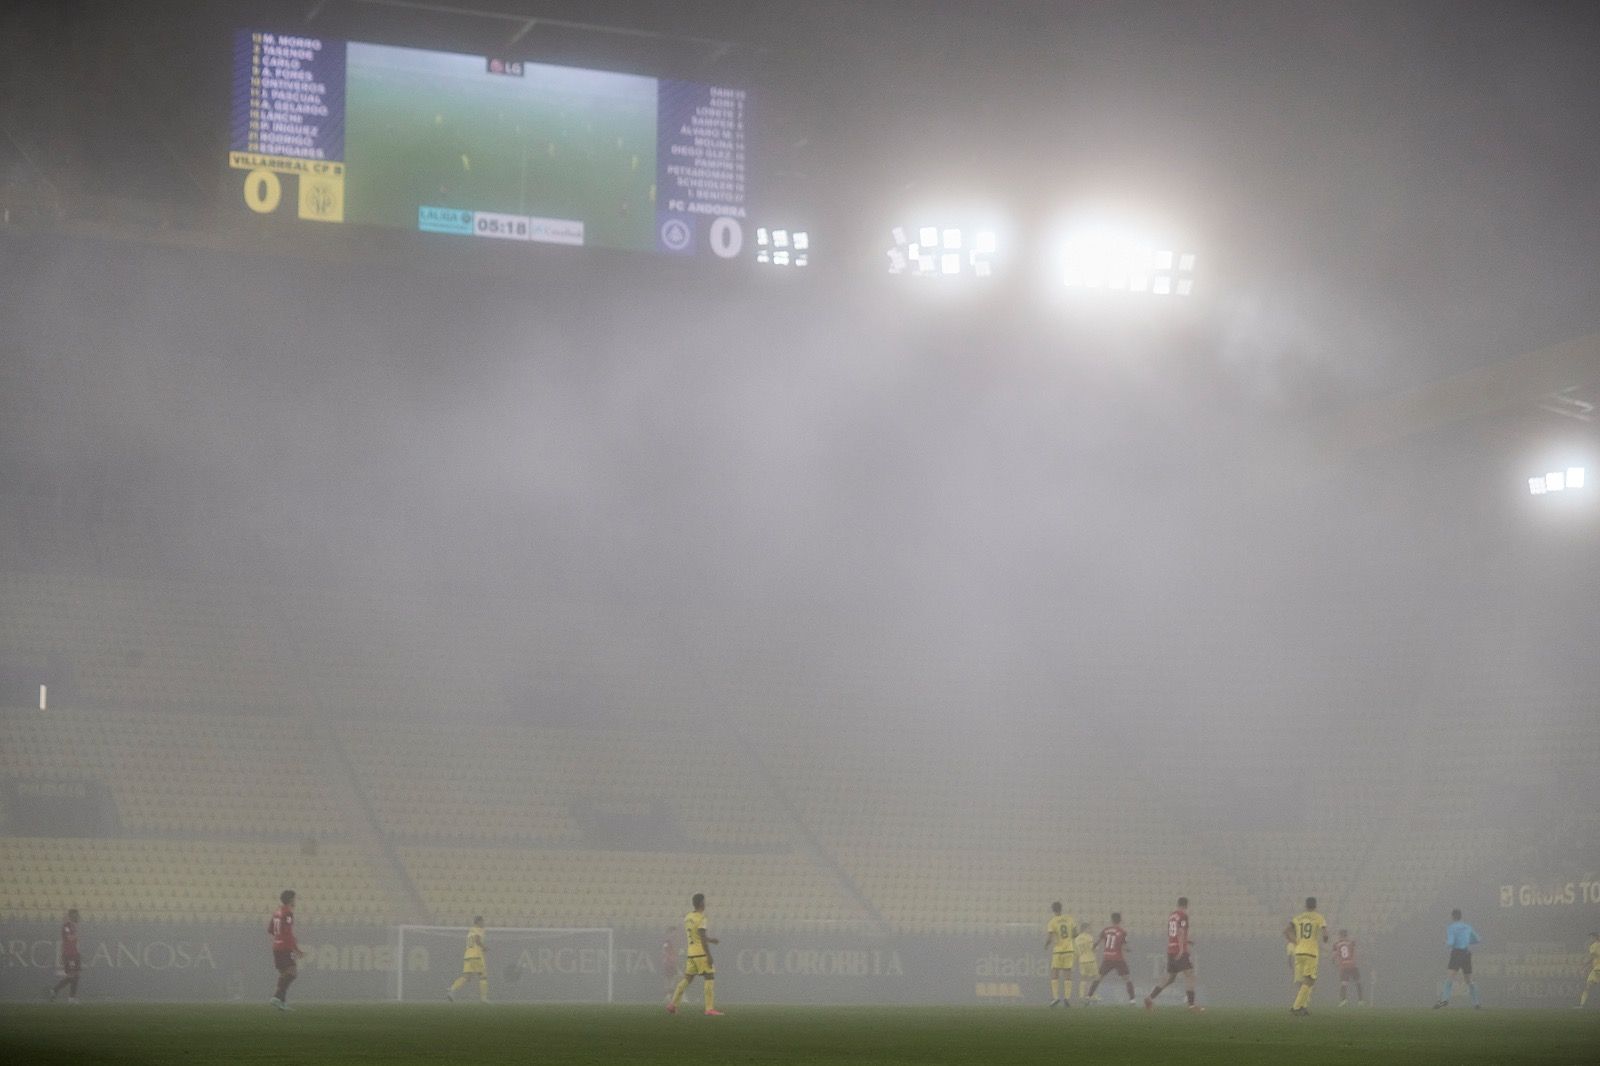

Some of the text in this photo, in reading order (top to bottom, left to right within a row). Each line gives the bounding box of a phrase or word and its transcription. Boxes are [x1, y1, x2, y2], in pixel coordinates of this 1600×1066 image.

[262, 55, 301, 70] CARLO
[505, 61, 521, 75] LG
[261, 77, 327, 94] ONTIVEROS
[271, 89, 321, 105] PASCUAL
[671, 144, 704, 158] DIEGO
[694, 137, 734, 151] MOLINA
[233, 154, 342, 175] VILLARREAL CF B
[243, 169, 282, 215] 0
[696, 190, 734, 202] BENITO
[669, 199, 746, 218] FC ANDORRA
[477, 217, 527, 236] 05:18
[710, 216, 744, 259] 0
[1059, 924, 1068, 939] 8
[1299, 922, 1313, 939] 19
[1105, 935, 1116, 949] 11
[0, 940, 216, 969] RCEANOSA
[297, 943, 430, 972] PAMEA
[517, 946, 657, 975] ARGENTA
[975, 951, 1050, 977] altadia
